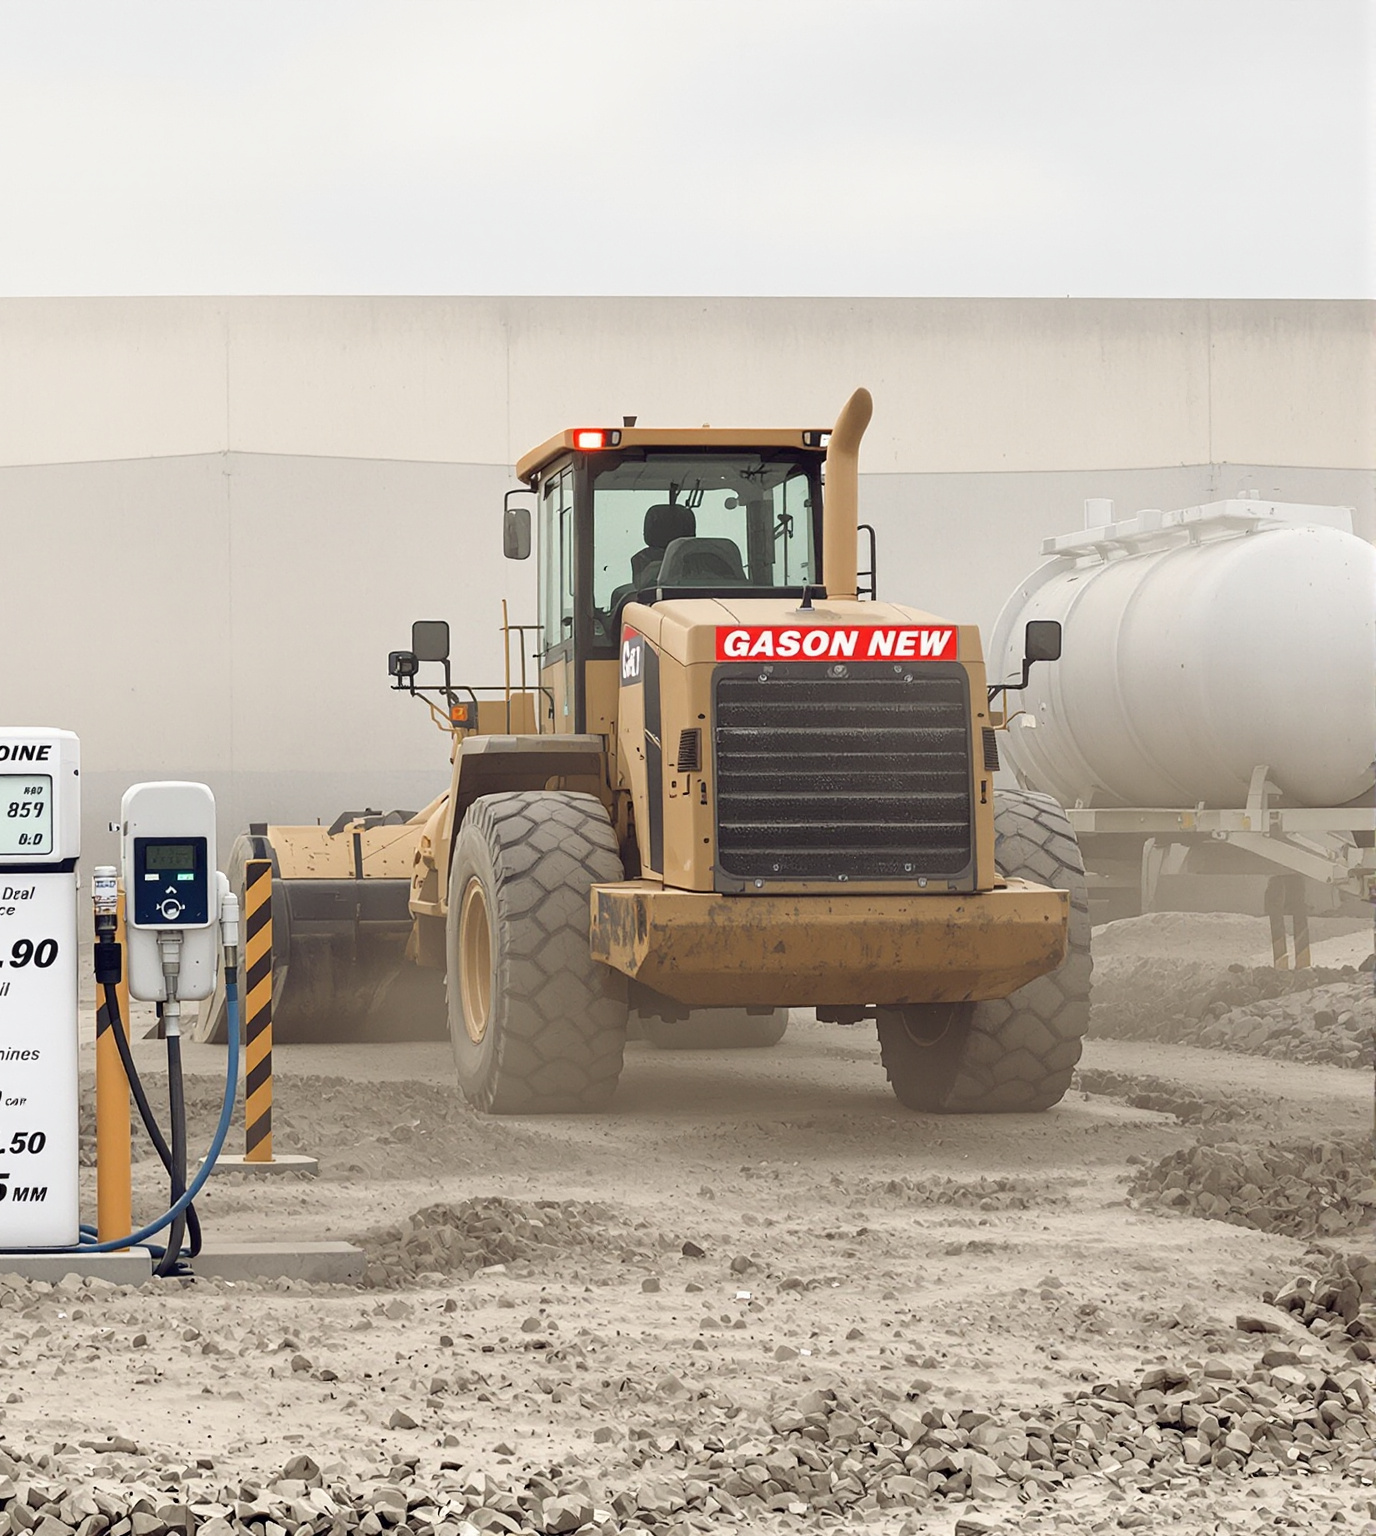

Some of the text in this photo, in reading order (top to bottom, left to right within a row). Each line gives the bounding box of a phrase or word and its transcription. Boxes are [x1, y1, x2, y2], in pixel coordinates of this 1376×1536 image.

[724, 630, 952, 657] GASON NEW
[7, 801, 44, 818] 859
[12, 1186, 48, 1202] MM
